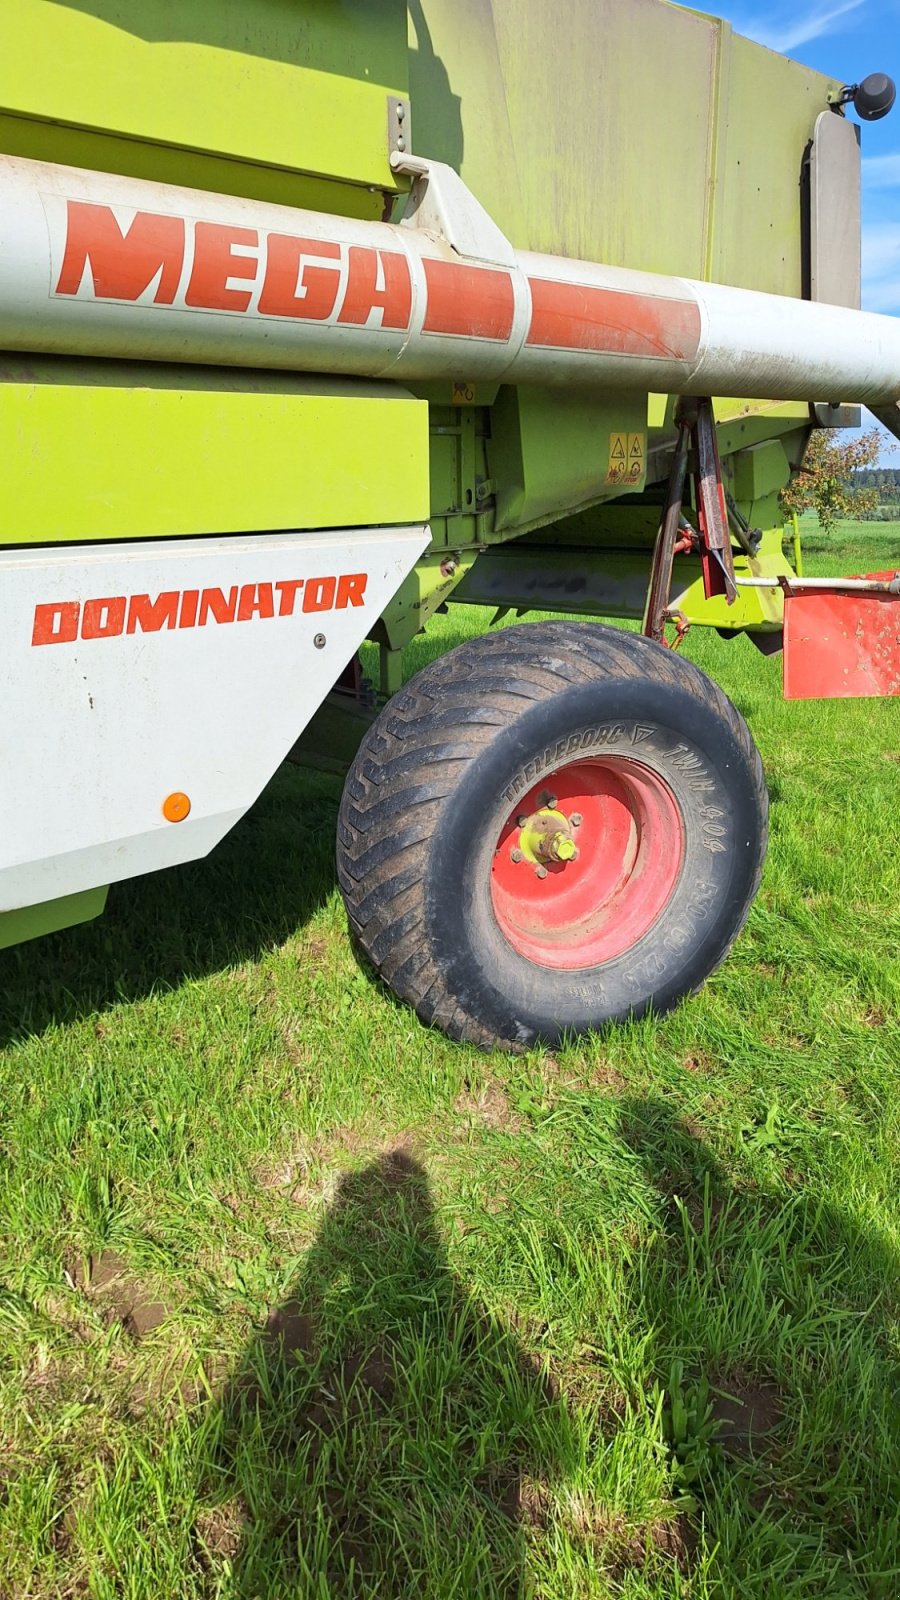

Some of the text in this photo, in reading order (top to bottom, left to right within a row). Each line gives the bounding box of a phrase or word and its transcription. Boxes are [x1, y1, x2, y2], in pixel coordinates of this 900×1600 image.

[56, 200, 412, 329] MEGA
[32, 573, 367, 646] DOMINATOR
[502, 724, 625, 802] TRELLEBORG
[663, 743, 728, 853] TWIN 404
